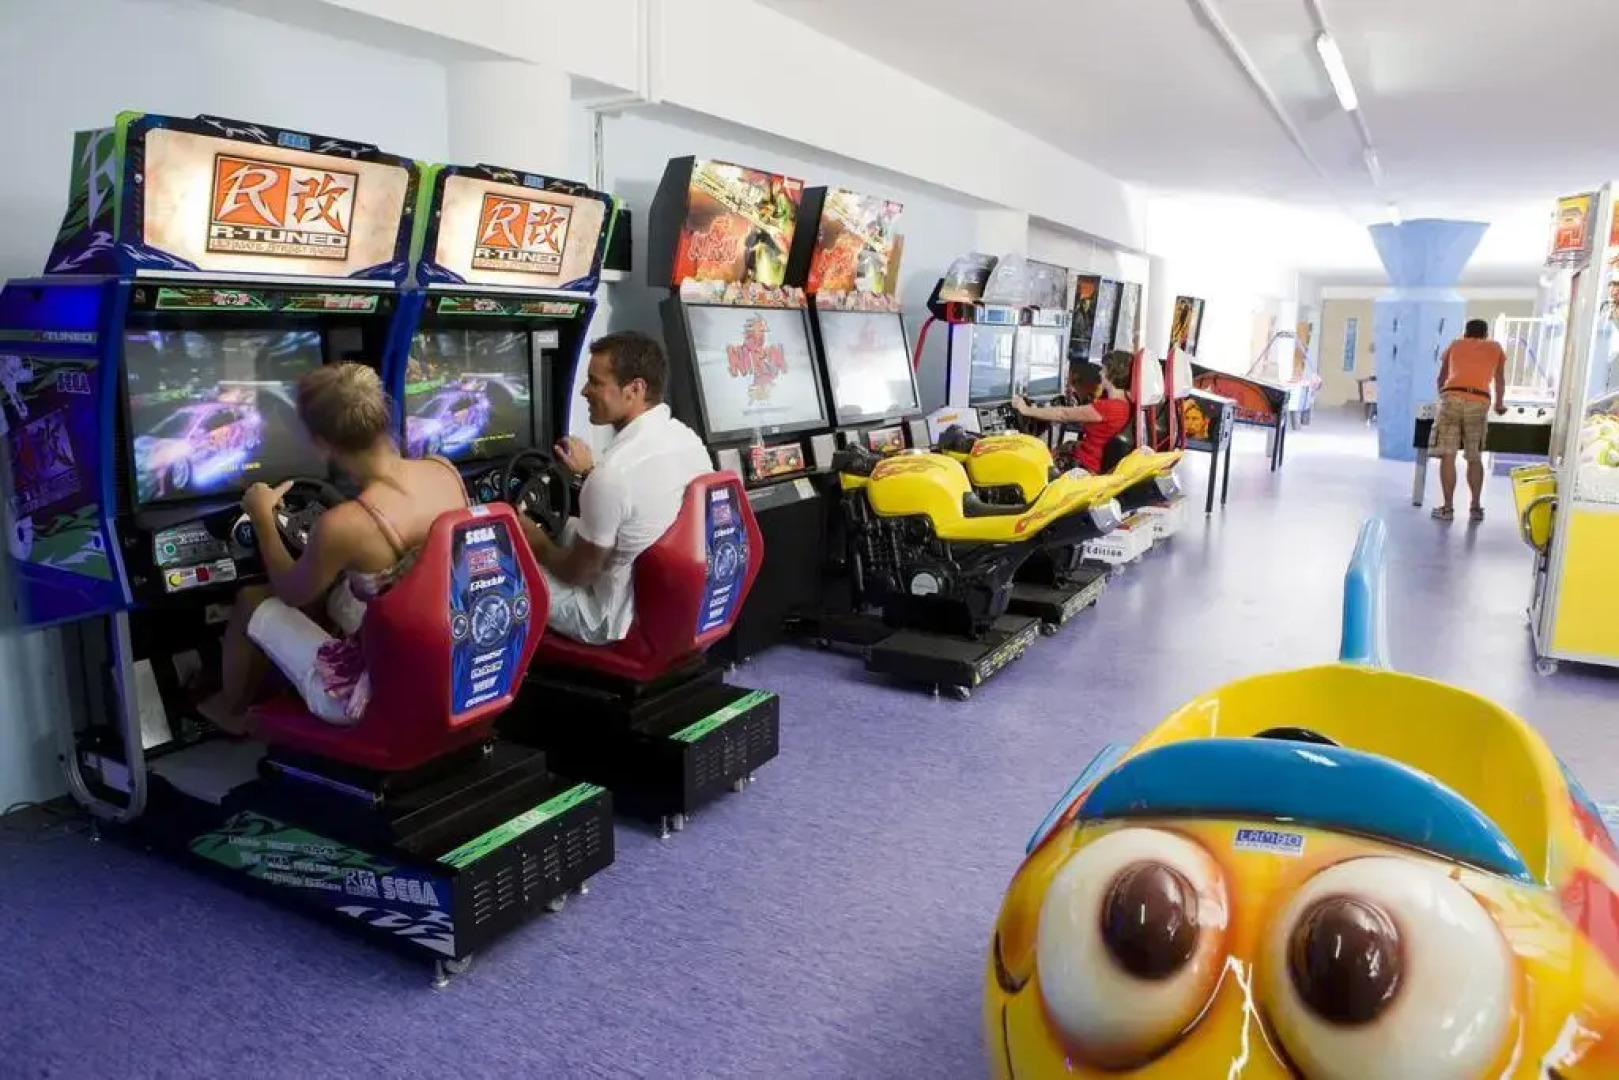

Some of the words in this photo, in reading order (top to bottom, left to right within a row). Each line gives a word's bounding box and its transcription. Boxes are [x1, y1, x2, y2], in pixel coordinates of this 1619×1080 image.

[277, 131, 311, 150] SEGA
[217, 164, 281, 227] R
[293, 173, 348, 232] 改
[210, 225, 349, 247] R-TUNED
[480, 200, 522, 249] R
[529, 206, 567, 254] 改
[474, 249, 560, 263] R-TUNED
[381, 875, 440, 907] SEGA
